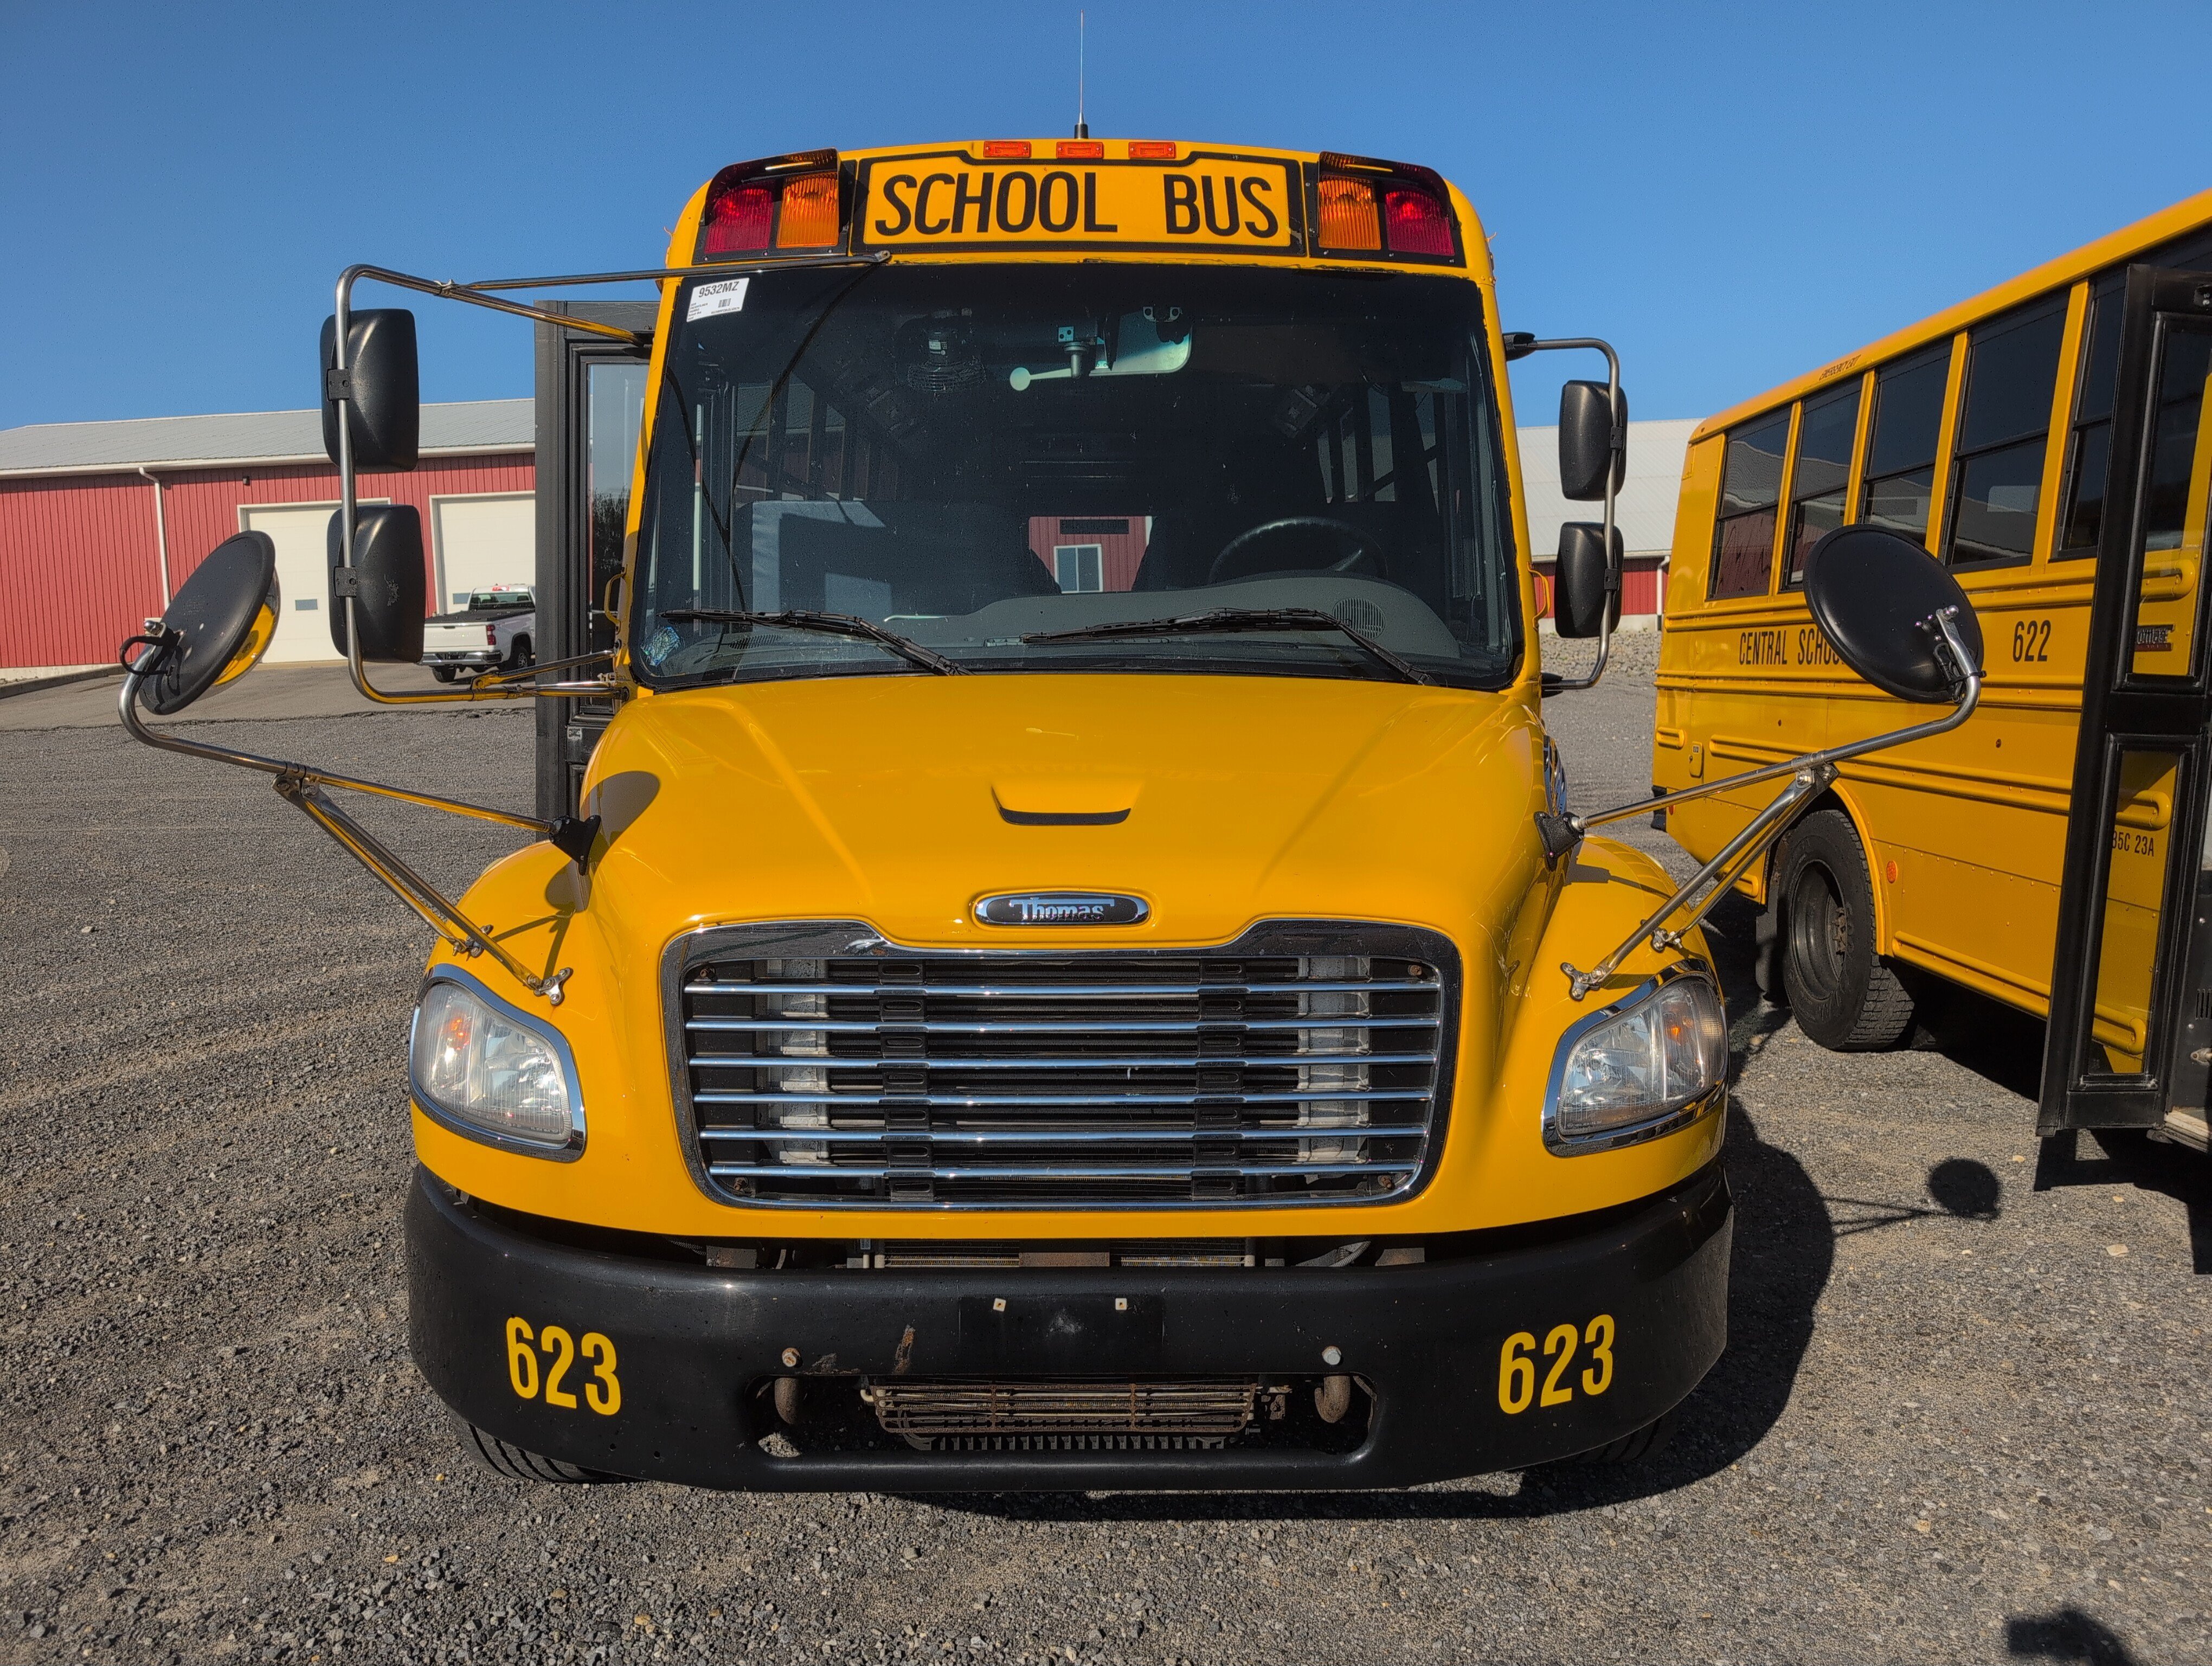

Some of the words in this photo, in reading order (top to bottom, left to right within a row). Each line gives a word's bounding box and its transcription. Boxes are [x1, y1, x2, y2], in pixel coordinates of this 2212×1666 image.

[875, 171, 1118, 236] SCHOOL
[1163, 174, 1278, 238] BUS
[699, 281, 739, 297] 9532MZ
[1739, 630, 1787, 665] CENTRAL
[1798, 628, 1846, 665] SCHO
[2012, 619, 2052, 662] 622
[2134, 835, 2154, 856] 23A
[1009, 896, 1115, 922] Thomas
[506, 1316, 622, 1415] 623
[1498, 1314, 1615, 1414] 623
